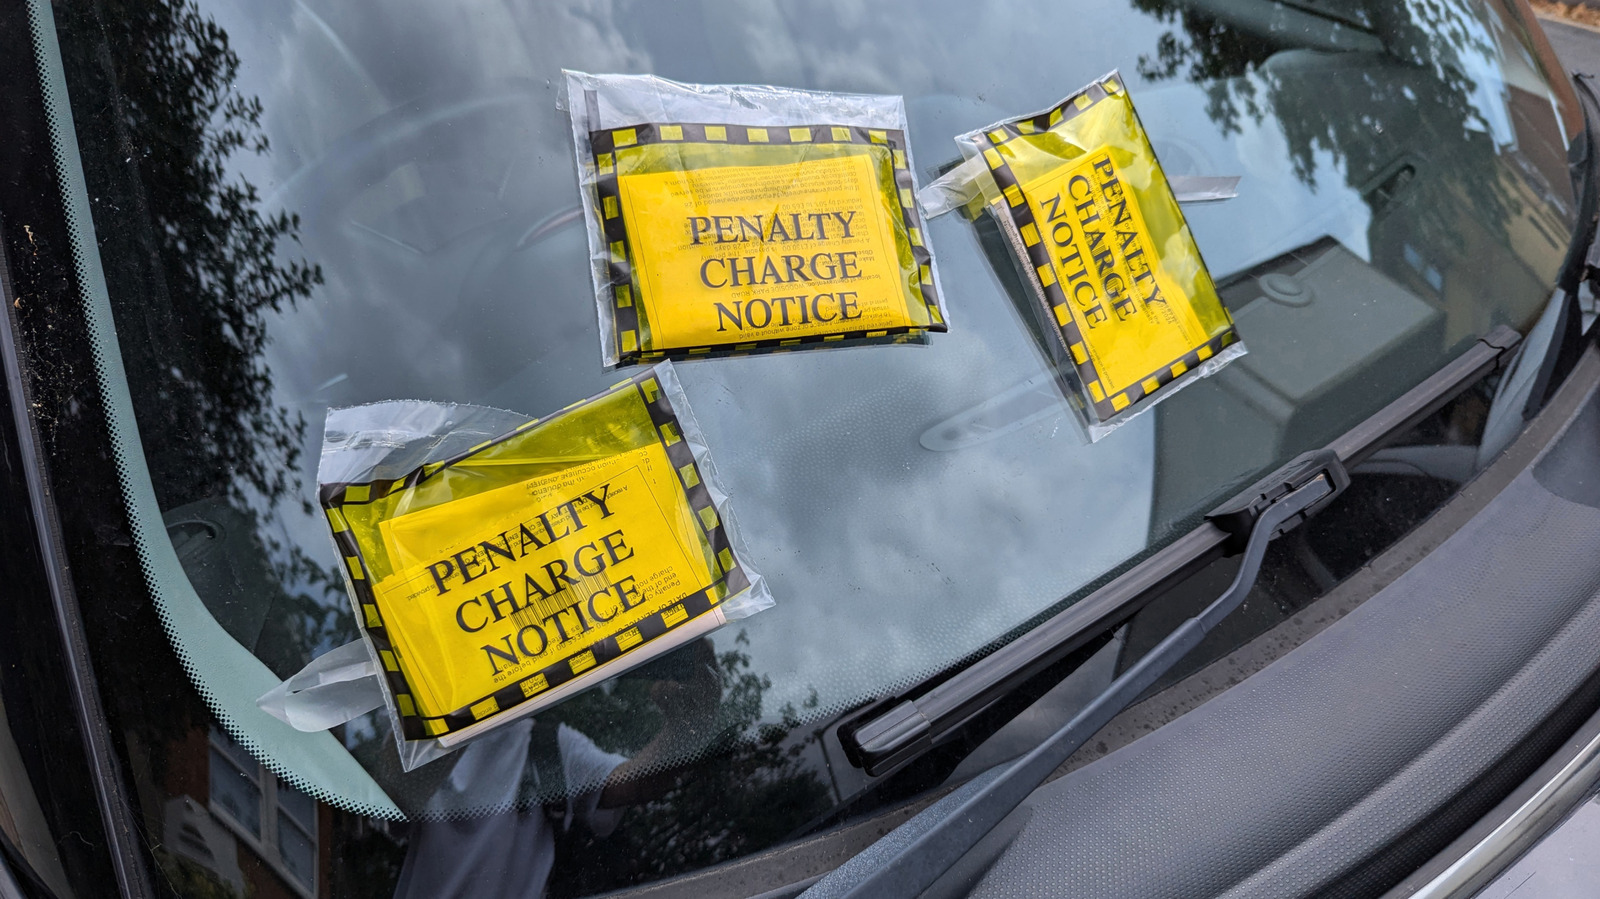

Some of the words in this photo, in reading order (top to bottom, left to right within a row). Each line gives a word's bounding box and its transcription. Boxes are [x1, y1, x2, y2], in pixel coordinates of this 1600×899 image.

[687, 211, 856, 245] PENALTY
[1092, 155, 1168, 306] PENALTY
[1068, 175, 1138, 322] CHARGE
[700, 251, 862, 289] CHARGE
[1040, 193, 1108, 329] NOTICE
[730, 290, 750, 298] ROAD
[751, 287, 769, 295] PARK
[713, 291, 862, 332] NOTICE
[738, 331, 753, 339] valid
[760, 327, 784, 336] without
[425, 483, 614, 596] PENALTY
[456, 529, 634, 632] CHARGE
[650, 564, 674, 581] charge
[662, 572, 677, 583] end
[640, 584, 654, 596] the
[653, 577, 681, 597] Penalty
[481, 575, 645, 676] NOTICE
[530, 649, 549, 663] paid
[492, 672, 507, 684] the
[505, 659, 532, 678] before
